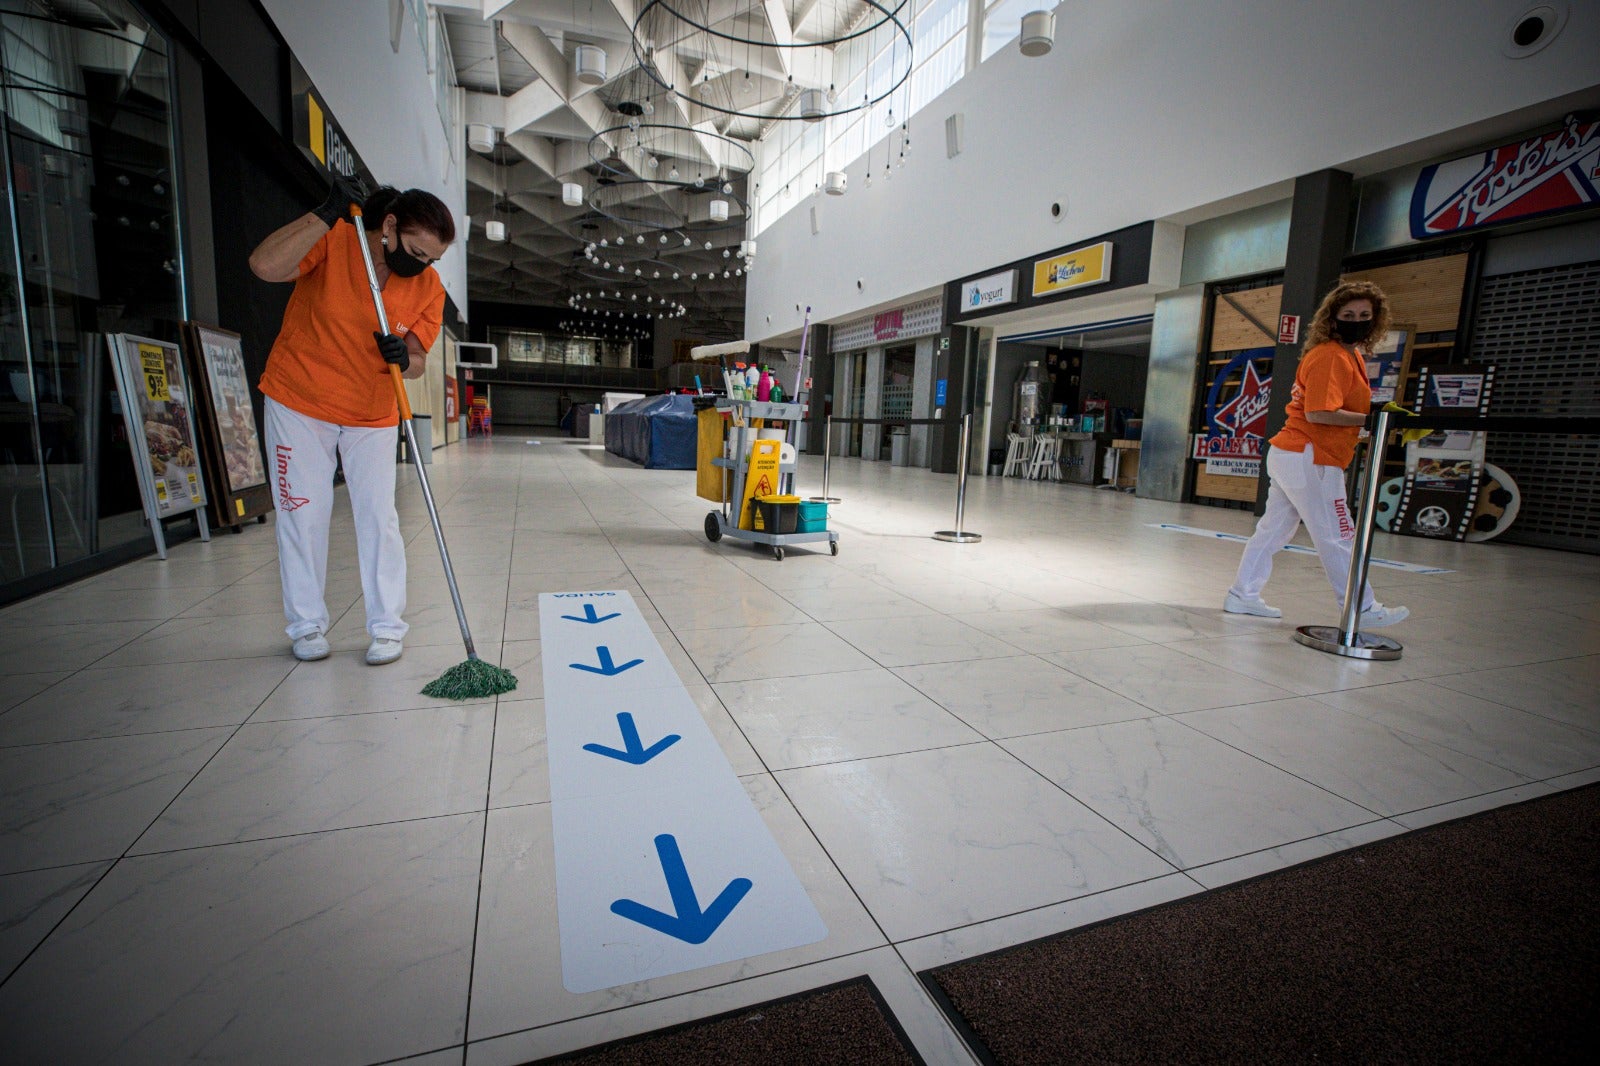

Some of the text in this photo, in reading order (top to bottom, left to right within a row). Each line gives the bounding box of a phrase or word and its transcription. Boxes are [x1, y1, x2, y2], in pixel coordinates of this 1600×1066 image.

[1457, 114, 1582, 228] Foster's
[1234, 386, 1271, 428] Foste
[1195, 436, 1263, 457] HOLLYW
